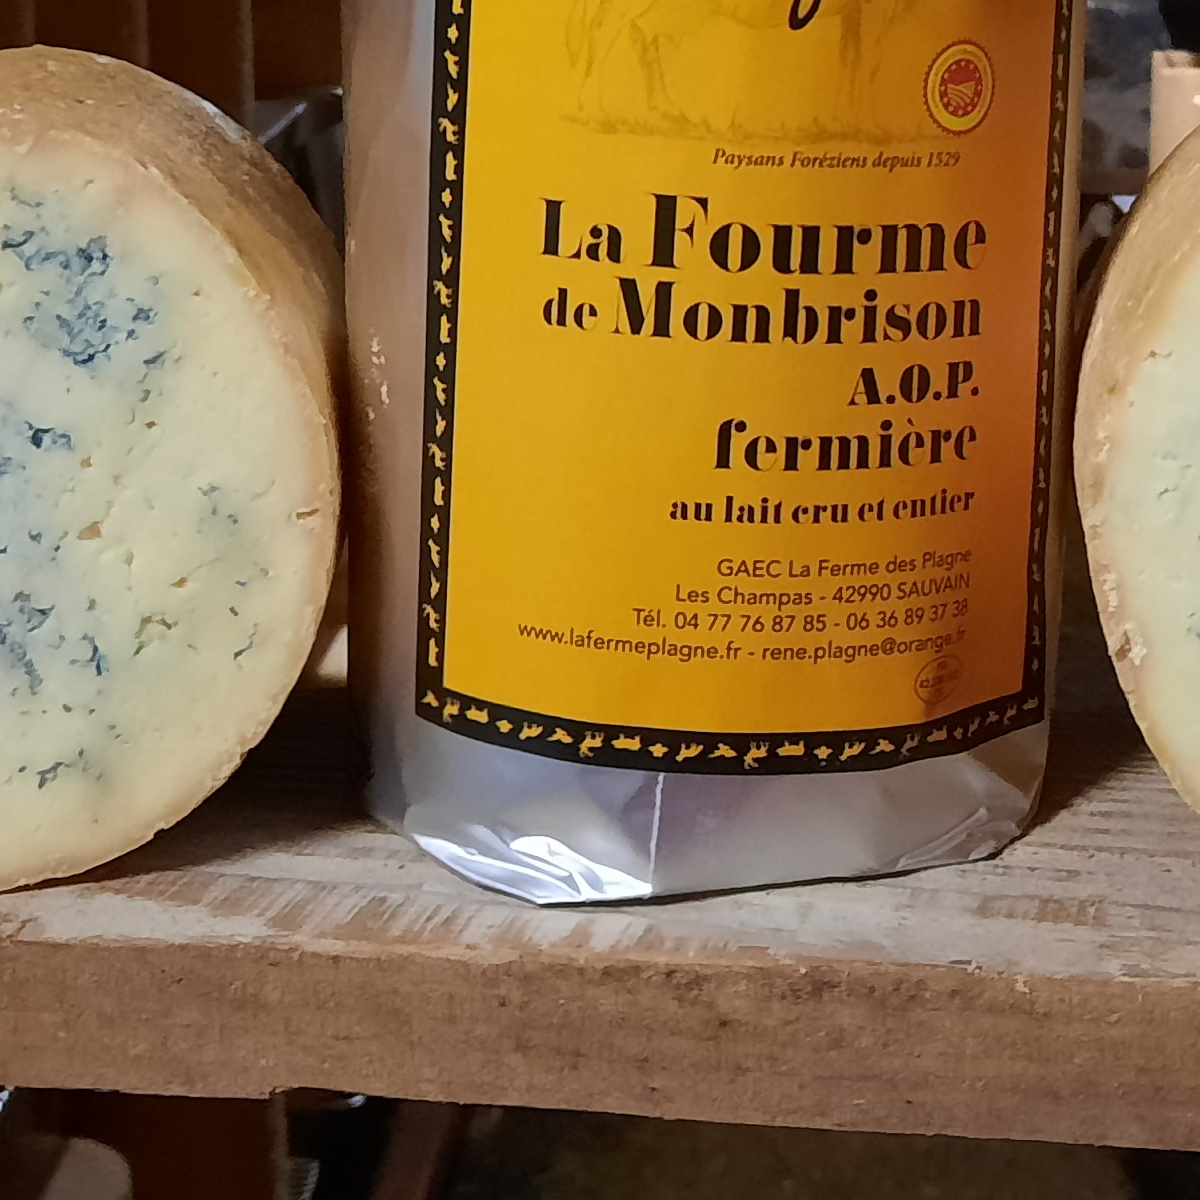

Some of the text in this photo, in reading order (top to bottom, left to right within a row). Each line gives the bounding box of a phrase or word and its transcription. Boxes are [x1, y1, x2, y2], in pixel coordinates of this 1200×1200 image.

[712, 148, 961, 172] Paysans Foréziens depuis 1529
[539, 192, 988, 275] La Fourme
[542, 276, 982, 345] de Monbrison
[847, 360, 979, 407] A.O.P.
[711, 418, 977, 472] fermière
[669, 488, 976, 524] au lait cru et entier
[716, 550, 972, 578] GAEC La Ferme des Plagne
[675, 583, 710, 603] Les
[716, 585, 813, 611] Champas
[831, 582, 892, 605] 42990
[896, 572, 971, 600] SAUVAIN
[632, 607, 668, 629] Tél.
[674, 611, 700, 630] 04
[706, 613, 732, 633] 77
[739, 614, 765, 633] 76
[771, 614, 796, 633] 87
[802, 613, 827, 632] 85
[846, 611, 870, 631] 06
[876, 609, 899, 629] 36
[903, 606, 926, 626] 89
[930, 602, 948, 622] 37
[518, 623, 743, 663] www.lafermeplagne.fr
[761, 625, 967, 665] rene.plagne@orange.fr
